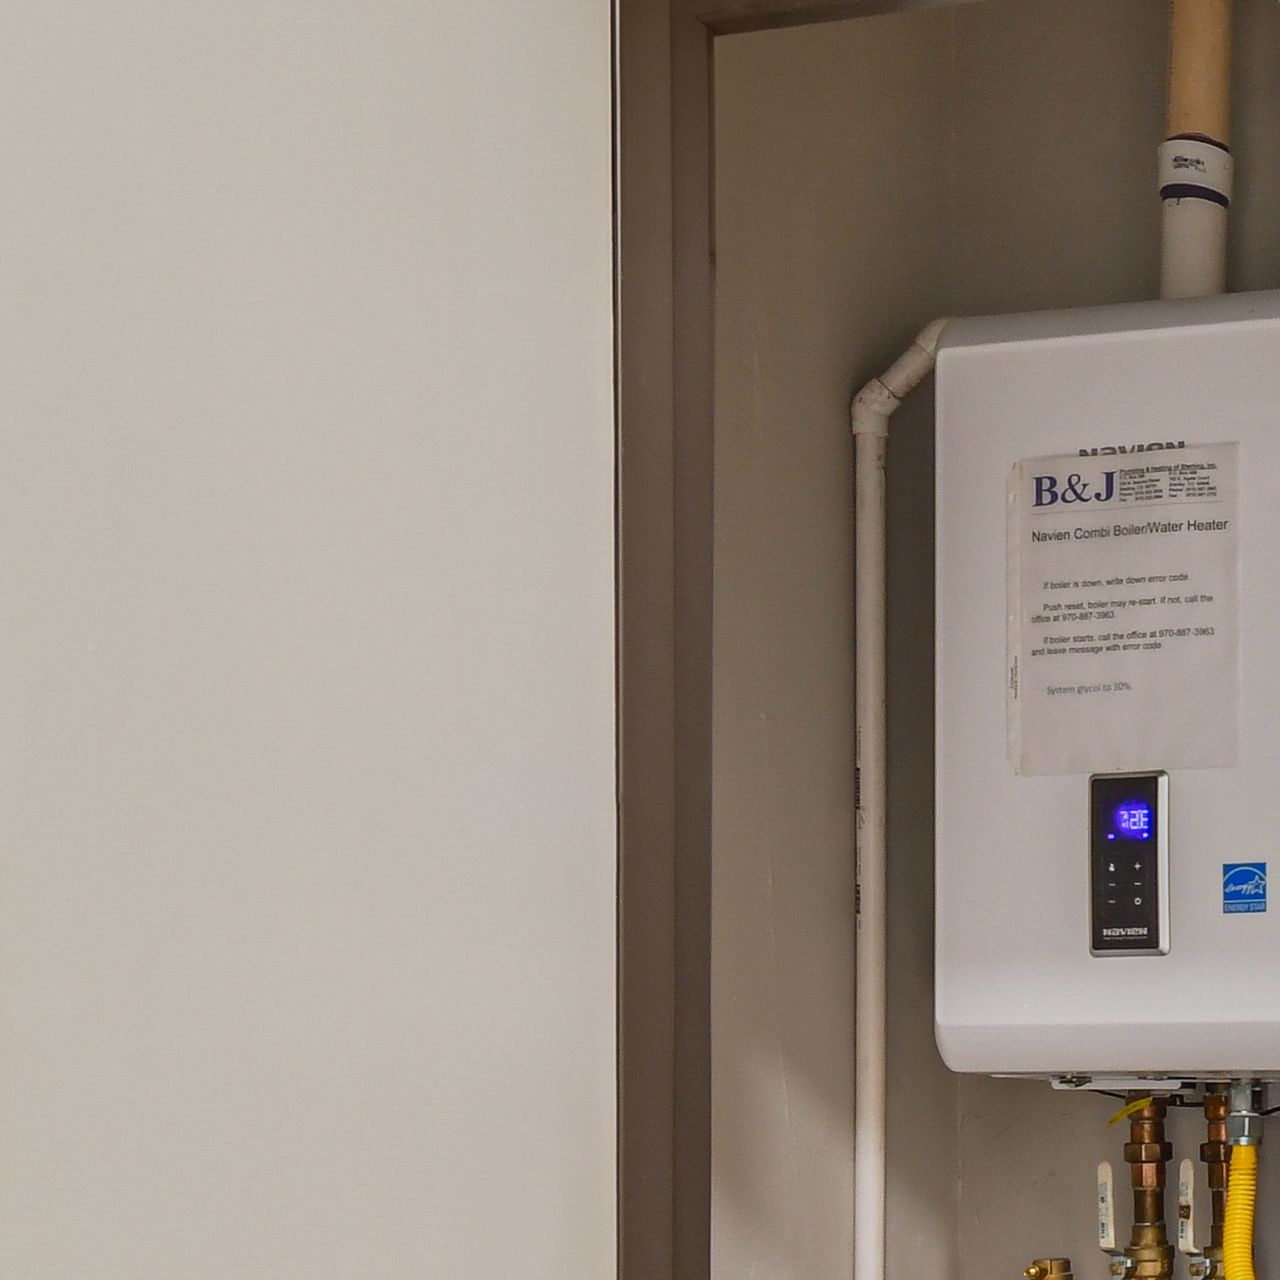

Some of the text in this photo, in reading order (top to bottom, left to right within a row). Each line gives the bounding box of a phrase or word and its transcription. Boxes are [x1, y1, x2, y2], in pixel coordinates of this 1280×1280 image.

[1031, 518, 1229, 543] Navien Combi Boiler/Water Heater
[1050, 581, 1071, 590] boiler
[1106, 577, 1124, 586] write
[1125, 576, 1147, 584] down
[1148, 575, 1167, 583] error
[1043, 602, 1062, 612] Push
[1087, 600, 1109, 610] boiler
[1110, 600, 1127, 609] may
[1184, 594, 1199, 603] call
[1200, 594, 1214, 602] the
[1031, 614, 1051, 623] office
[1052, 614, 1060, 622] at
[1050, 635, 1071, 644] boiler
[1097, 632, 1111, 641] call
[1112, 632, 1125, 640] the
[1126, 630, 1148, 639] office
[1148, 630, 1157, 638] at
[1031, 648, 1045, 656] and
[1047, 647, 1067, 655] leave
[1069, 645, 1104, 655] message
[1105, 643, 1121, 652] with
[1122, 643, 1141, 651] error
